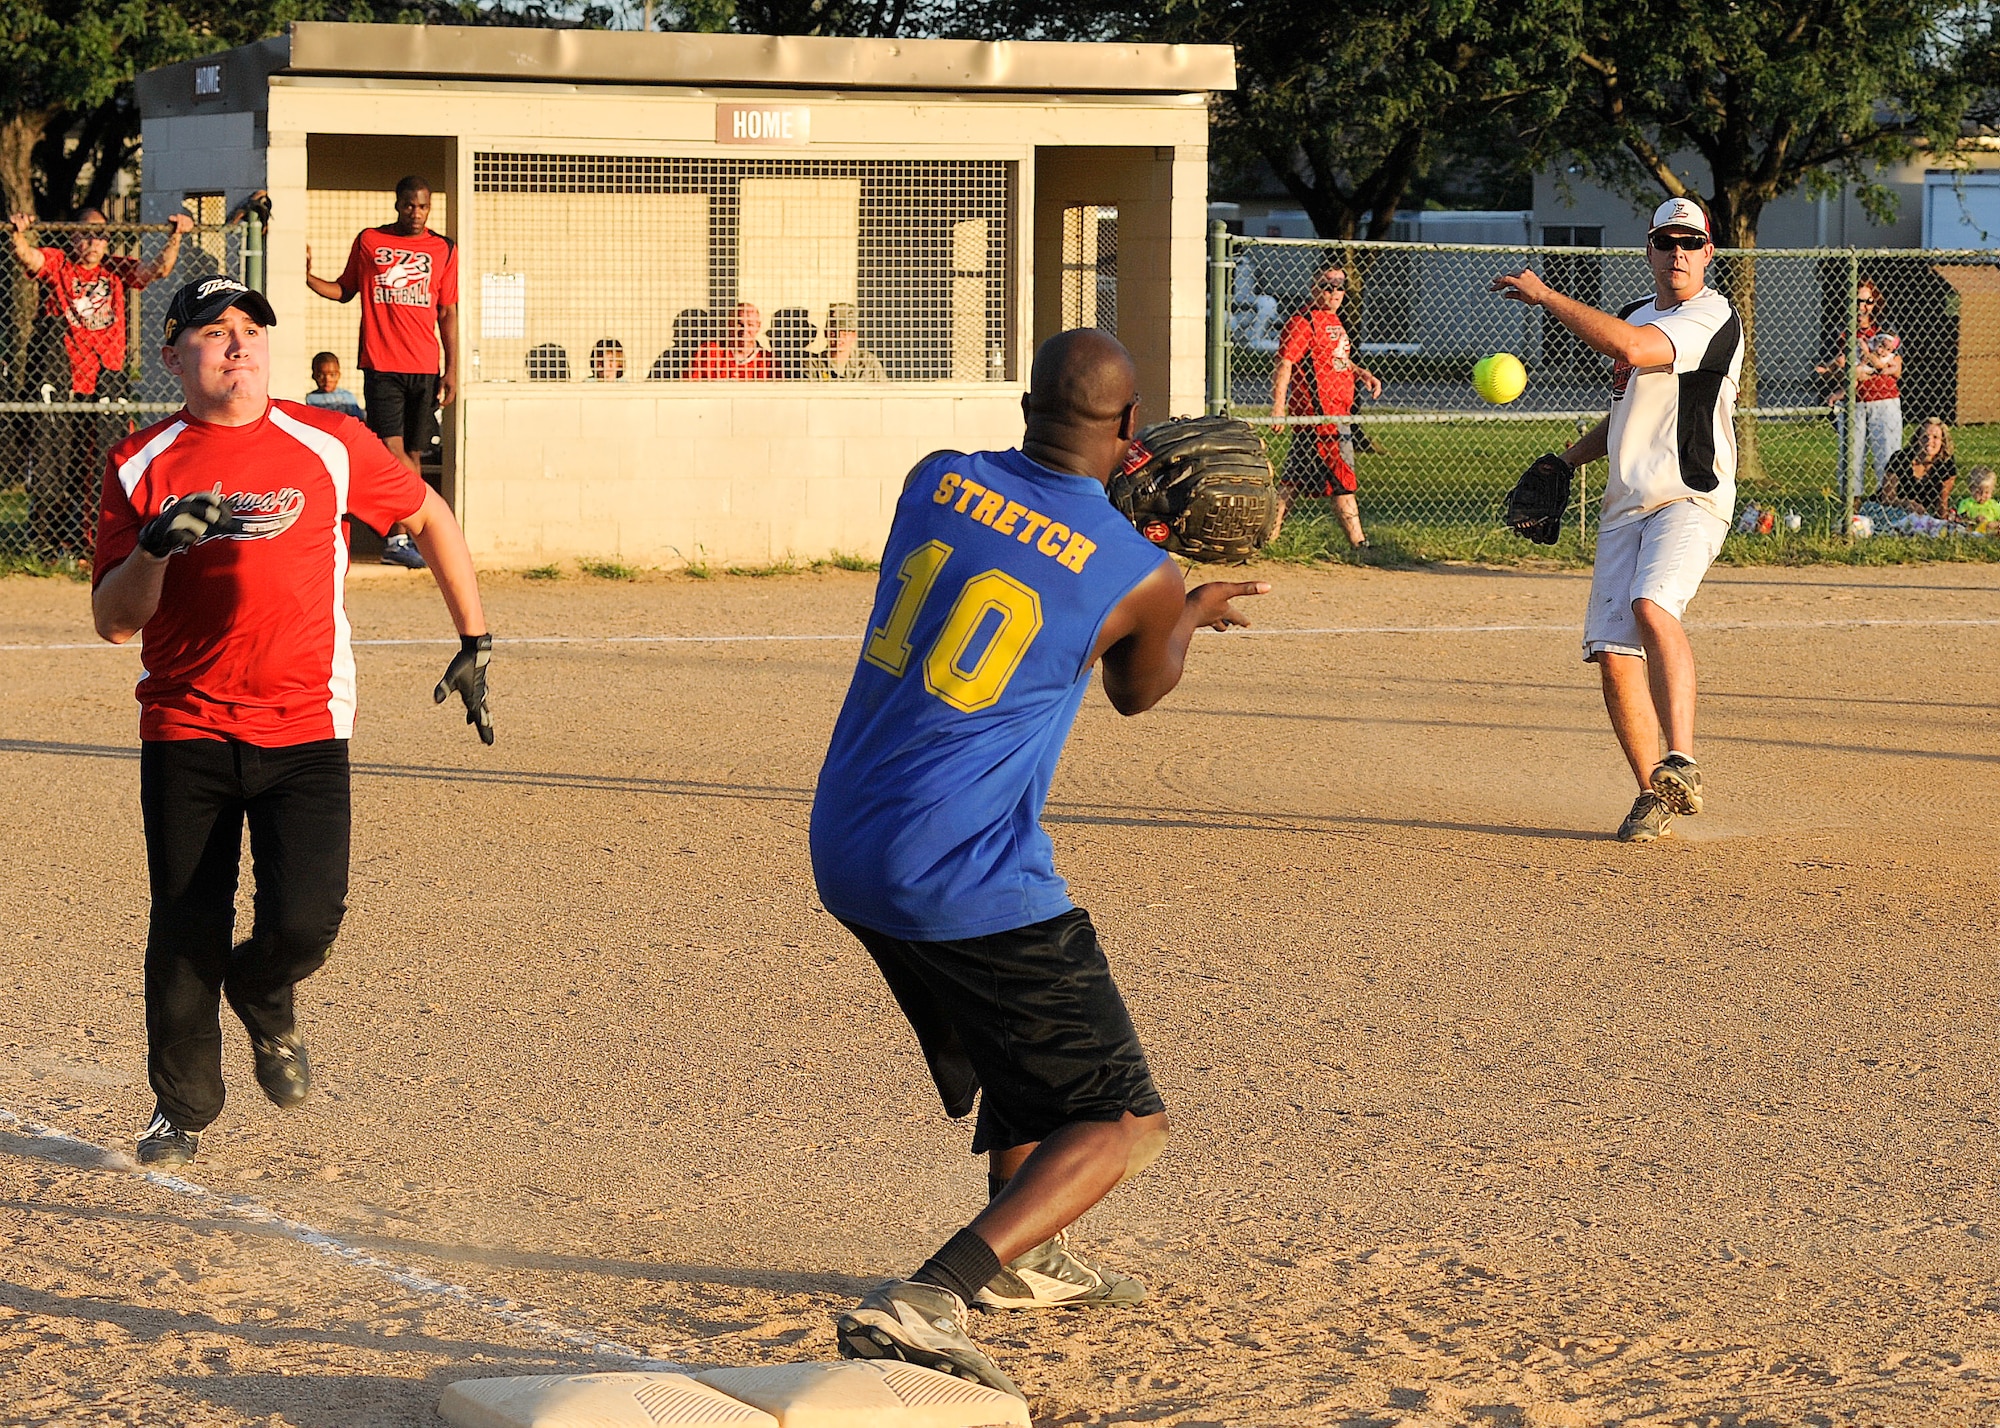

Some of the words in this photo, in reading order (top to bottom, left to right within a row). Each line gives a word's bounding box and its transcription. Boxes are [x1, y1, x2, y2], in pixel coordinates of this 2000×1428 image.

[733, 110, 793, 139] HOME
[374, 246, 432, 273] 373
[933, 472, 1097, 574] STRETCH
[863, 538, 1044, 714] 10
